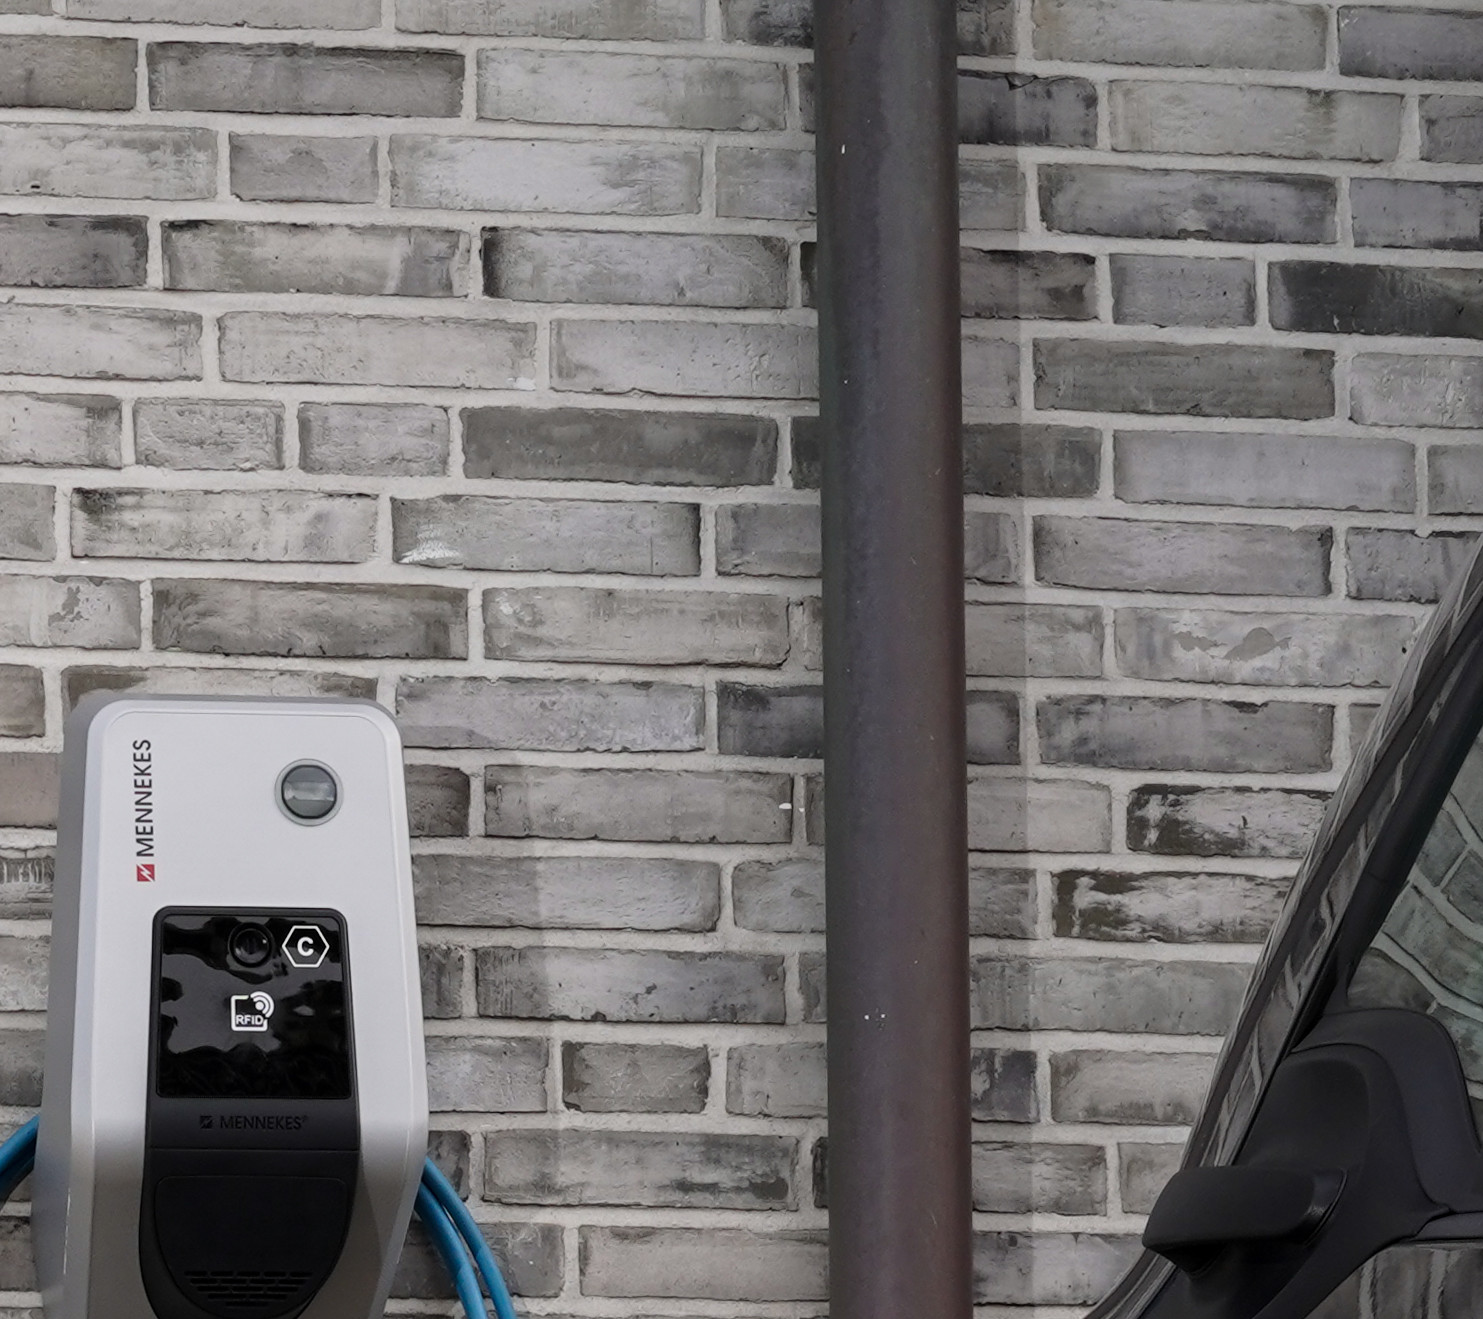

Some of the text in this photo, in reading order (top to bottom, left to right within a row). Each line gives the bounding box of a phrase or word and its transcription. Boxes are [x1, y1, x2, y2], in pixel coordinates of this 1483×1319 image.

[133, 739, 154, 857] MENNEKES
[297, 936, 314, 957] C
[235, 1014, 264, 1026] RFID
